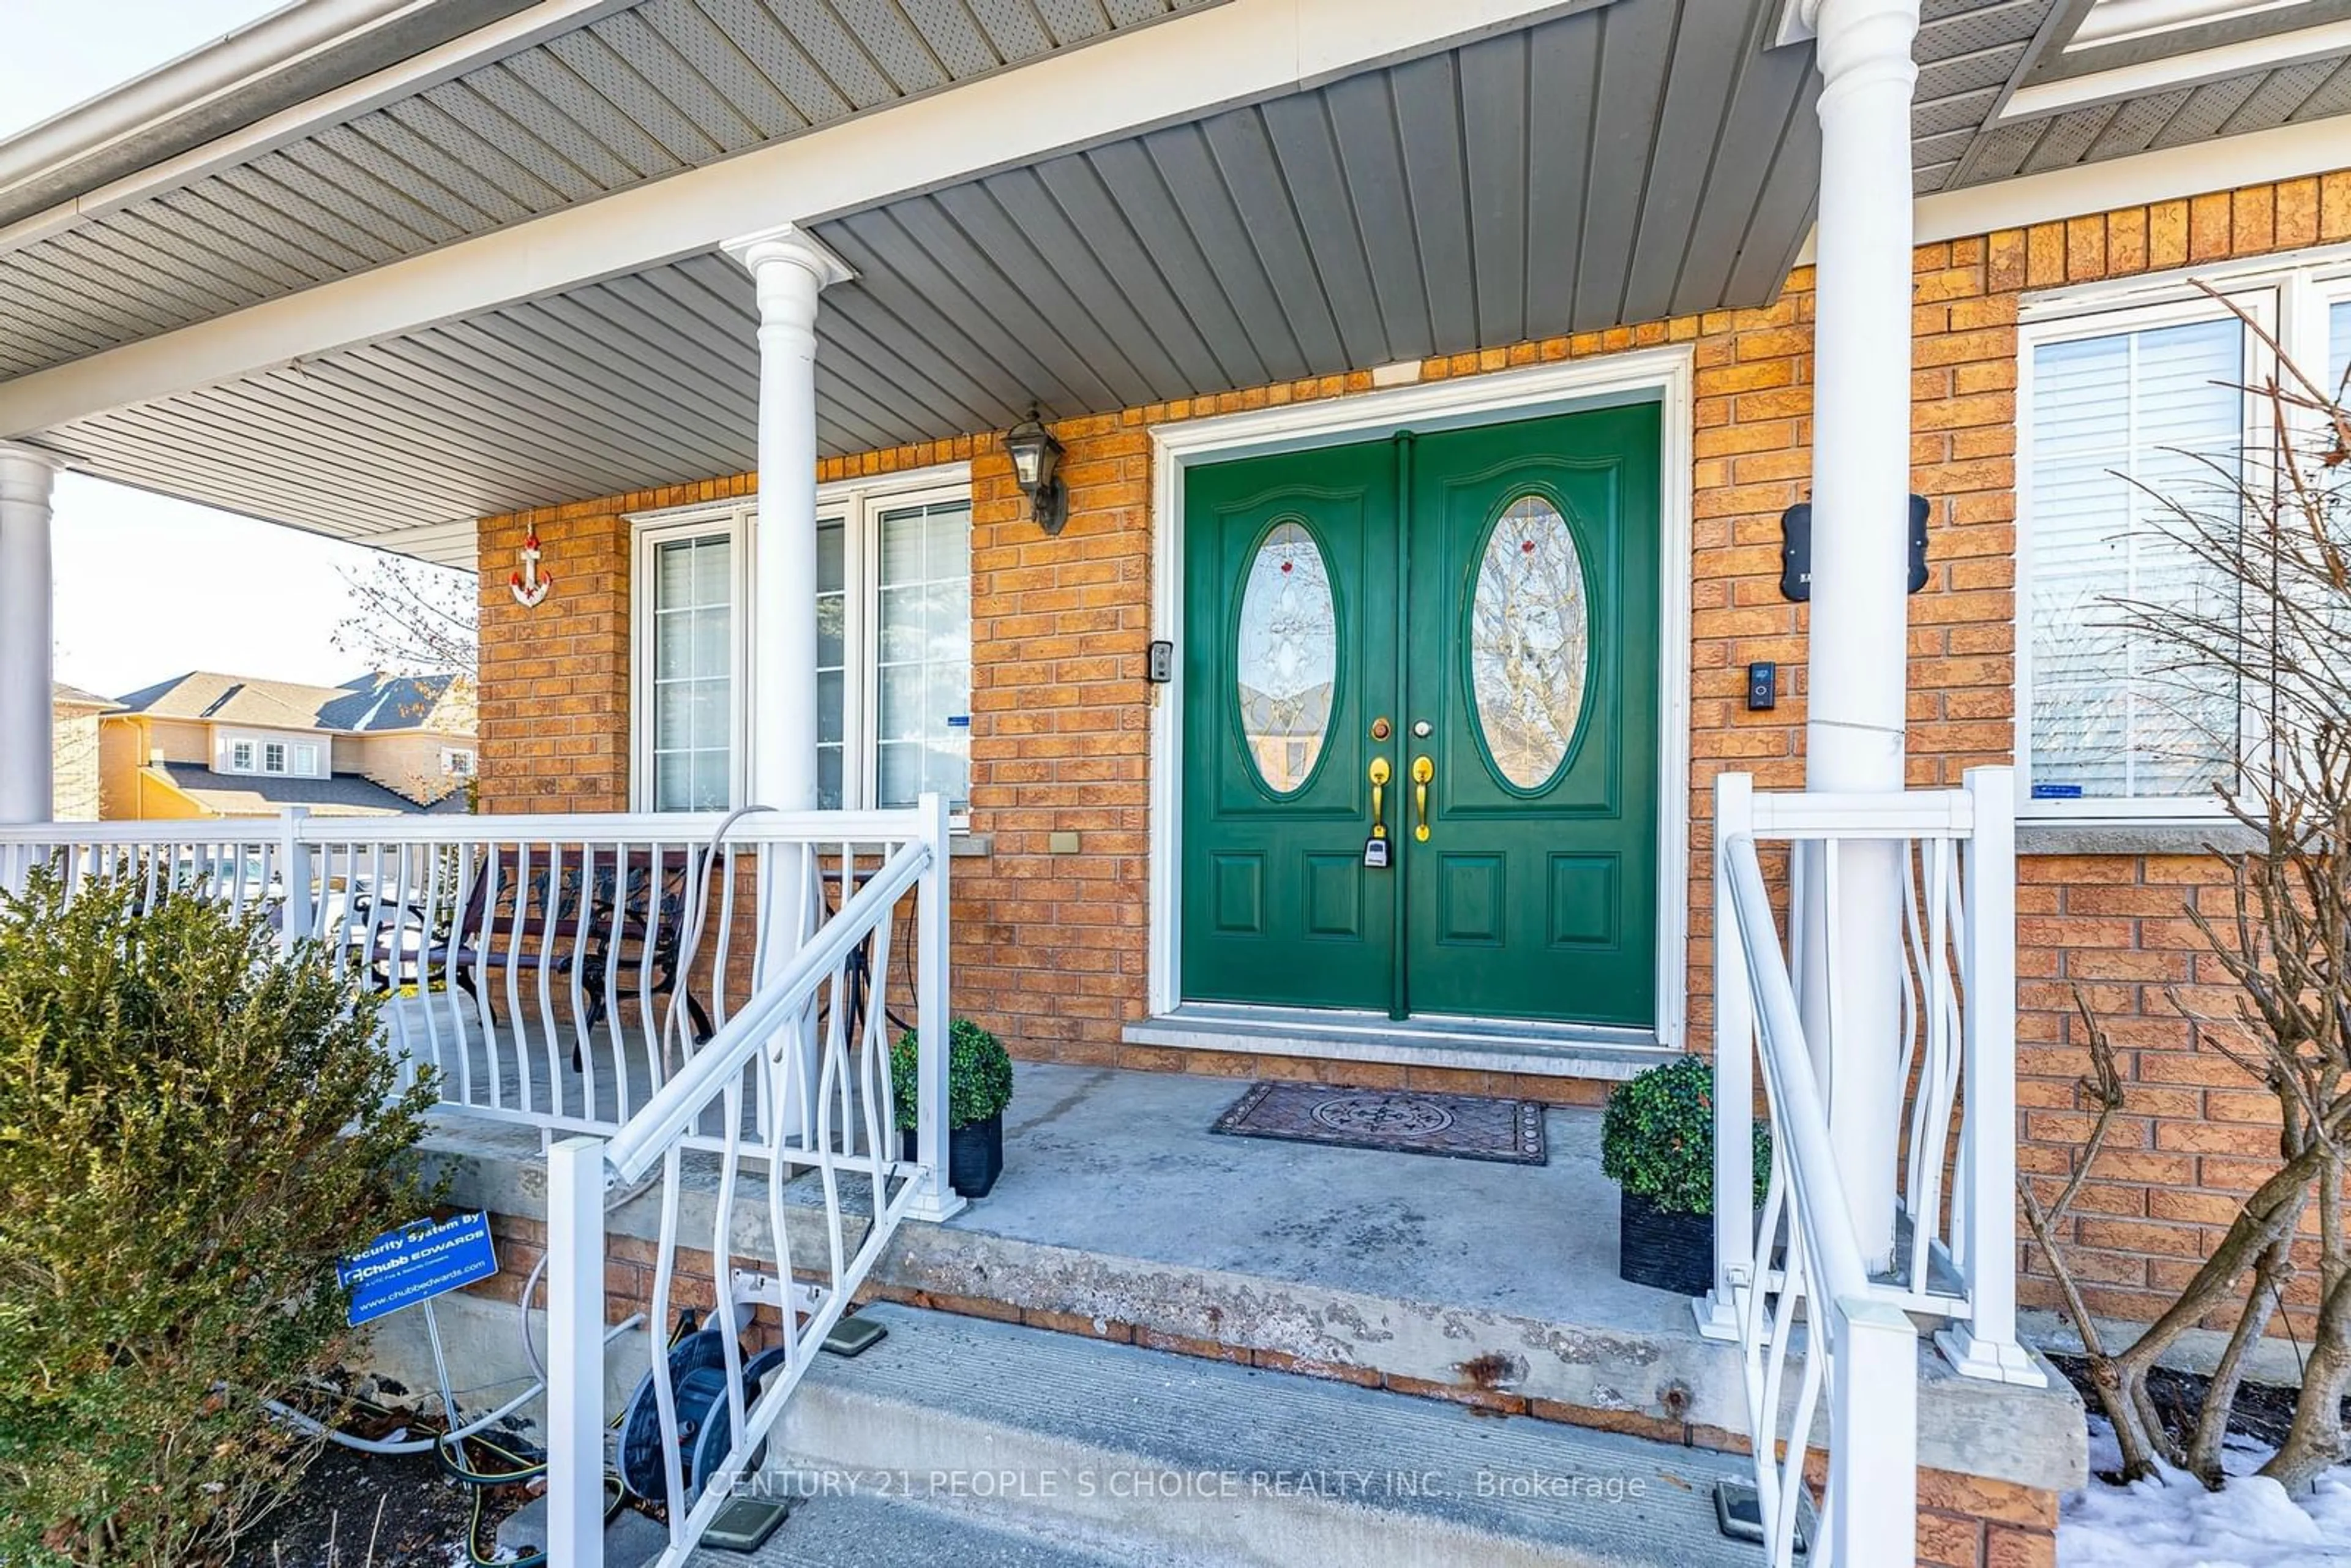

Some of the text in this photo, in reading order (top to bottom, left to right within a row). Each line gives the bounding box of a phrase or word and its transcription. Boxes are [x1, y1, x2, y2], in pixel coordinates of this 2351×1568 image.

[345, 1214, 479, 1262] ecurity System By
[363, 1256, 409, 1278] Chubb
[411, 1230, 484, 1261] EDWARDS
[359, 1260, 486, 1312] www.chubbedwards.com
